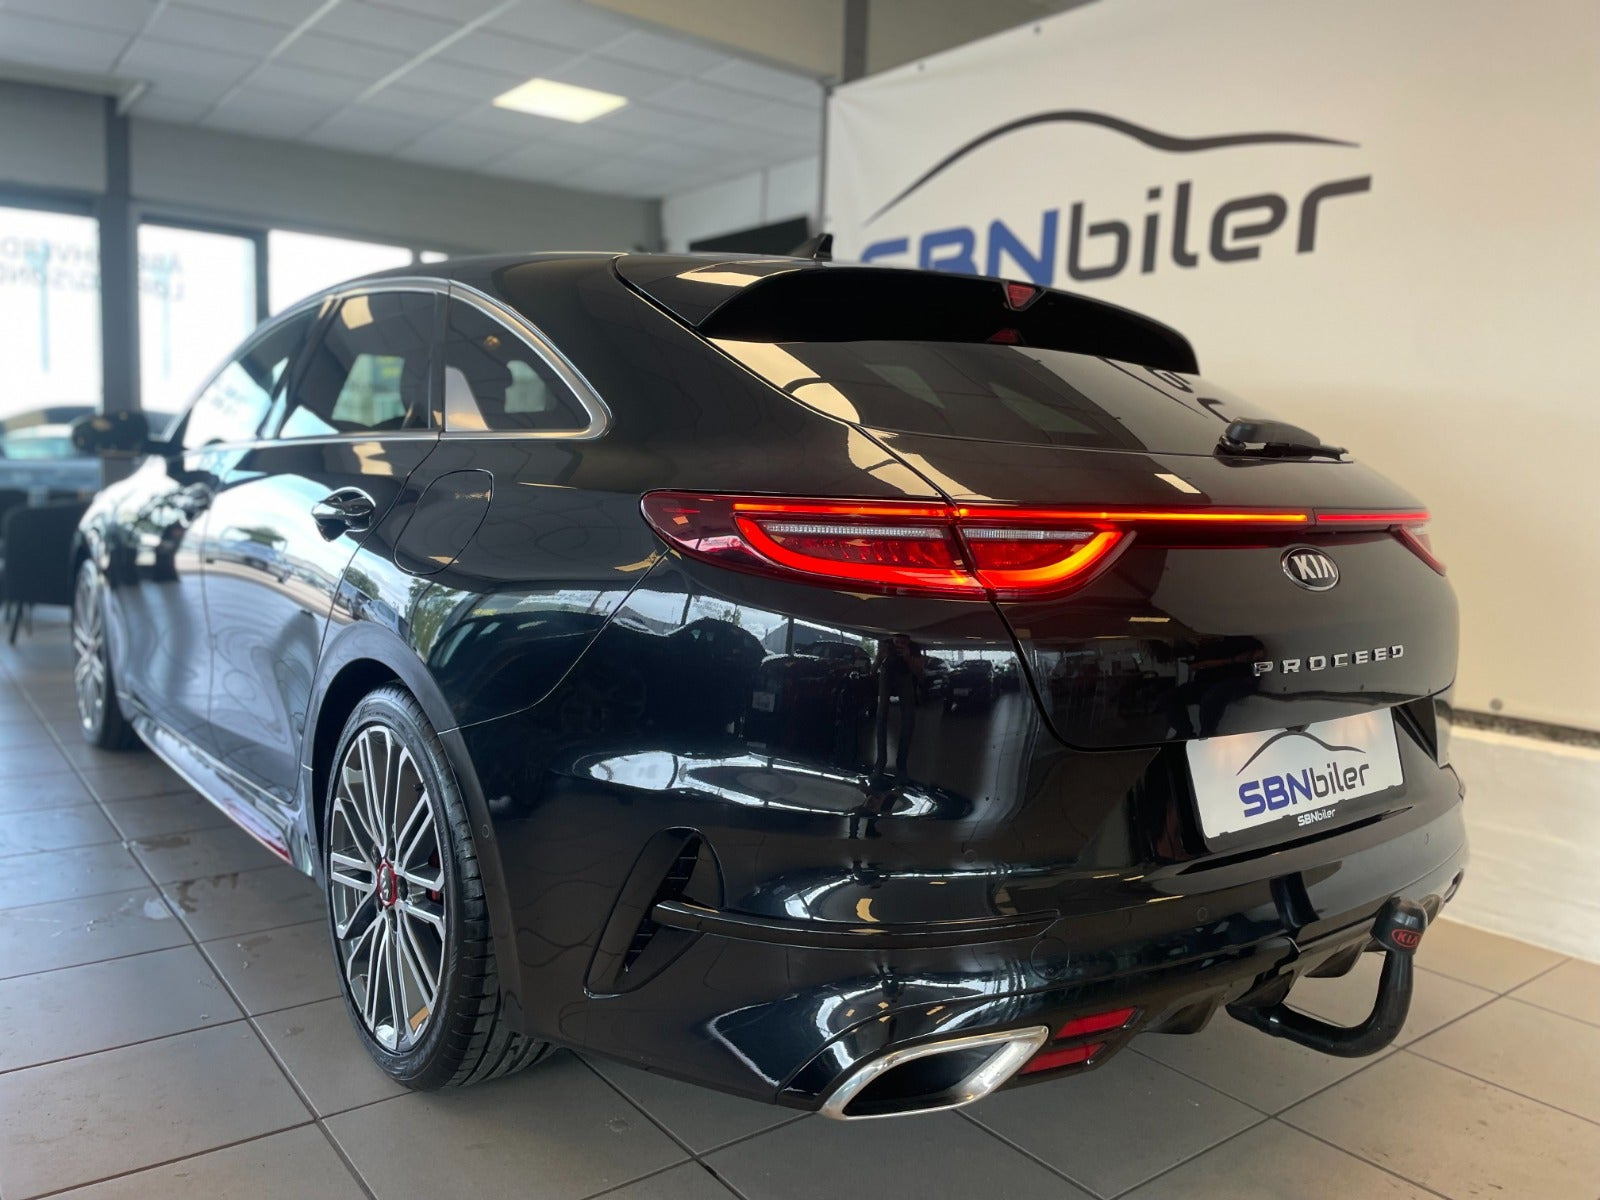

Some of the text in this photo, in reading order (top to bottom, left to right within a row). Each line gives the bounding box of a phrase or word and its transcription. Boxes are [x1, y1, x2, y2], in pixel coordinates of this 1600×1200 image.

[1291, 554, 1337, 580] KIA
[1252, 644, 1405, 677] PROCEED
[1238, 762, 1370, 818] SBNbiler
[1297, 808, 1336, 827] SBNbiler
[1396, 932, 1419, 944] KIA
